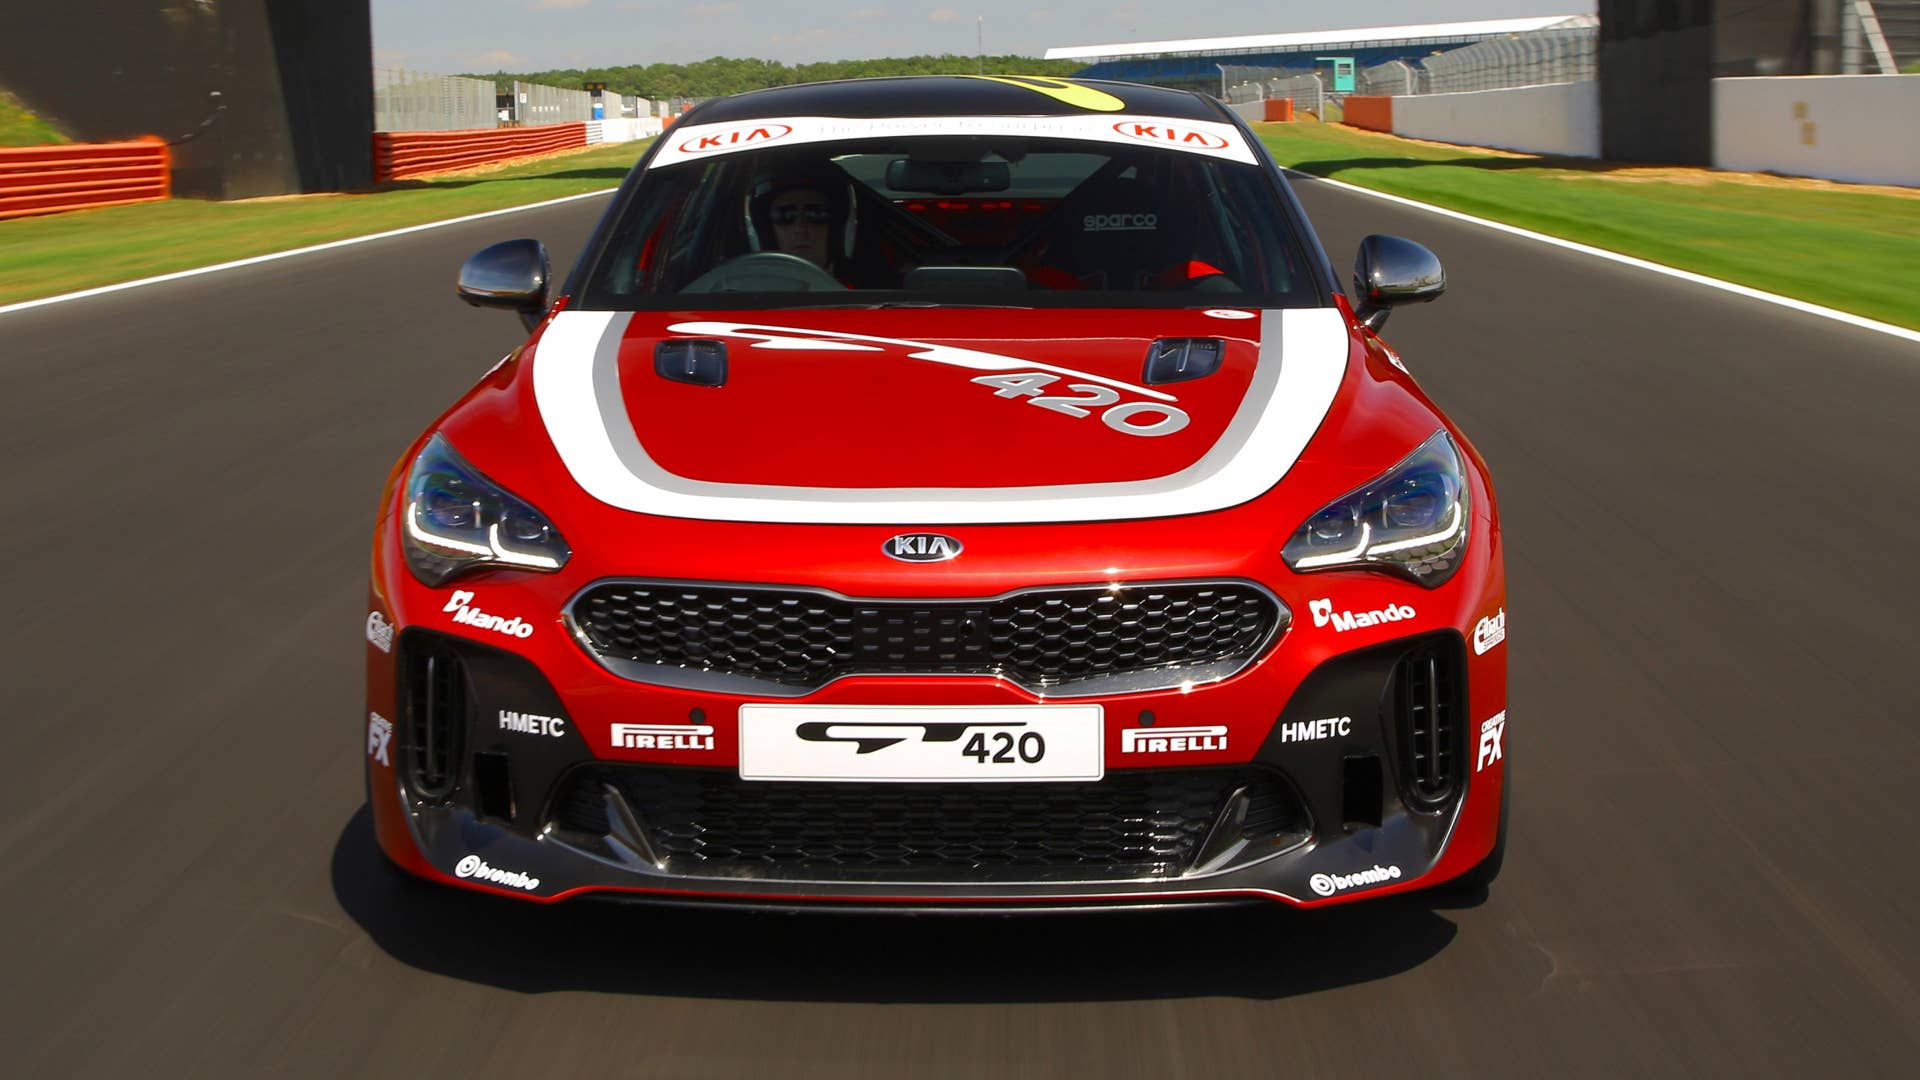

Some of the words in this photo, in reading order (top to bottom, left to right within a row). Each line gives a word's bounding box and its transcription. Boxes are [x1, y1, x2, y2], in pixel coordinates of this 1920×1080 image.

[699, 128, 772, 150] KIA
[1133, 123, 1209, 147] KIA
[1083, 214, 1157, 231] sparco
[970, 372, 1190, 437] 420
[894, 535, 953, 556] KIA
[452, 605, 534, 638] Mando
[1330, 603, 1416, 632] Mando
[499, 710, 565, 737] HMETC
[611, 723, 715, 750] PIRELLI
[1281, 716, 1351, 743] HMETC
[961, 731, 1046, 764] 420
[1121, 725, 1228, 753] PIRELLI
[1477, 721, 1505, 772] FX
[474, 861, 540, 890] brembo
[1330, 864, 1401, 890] brembo
